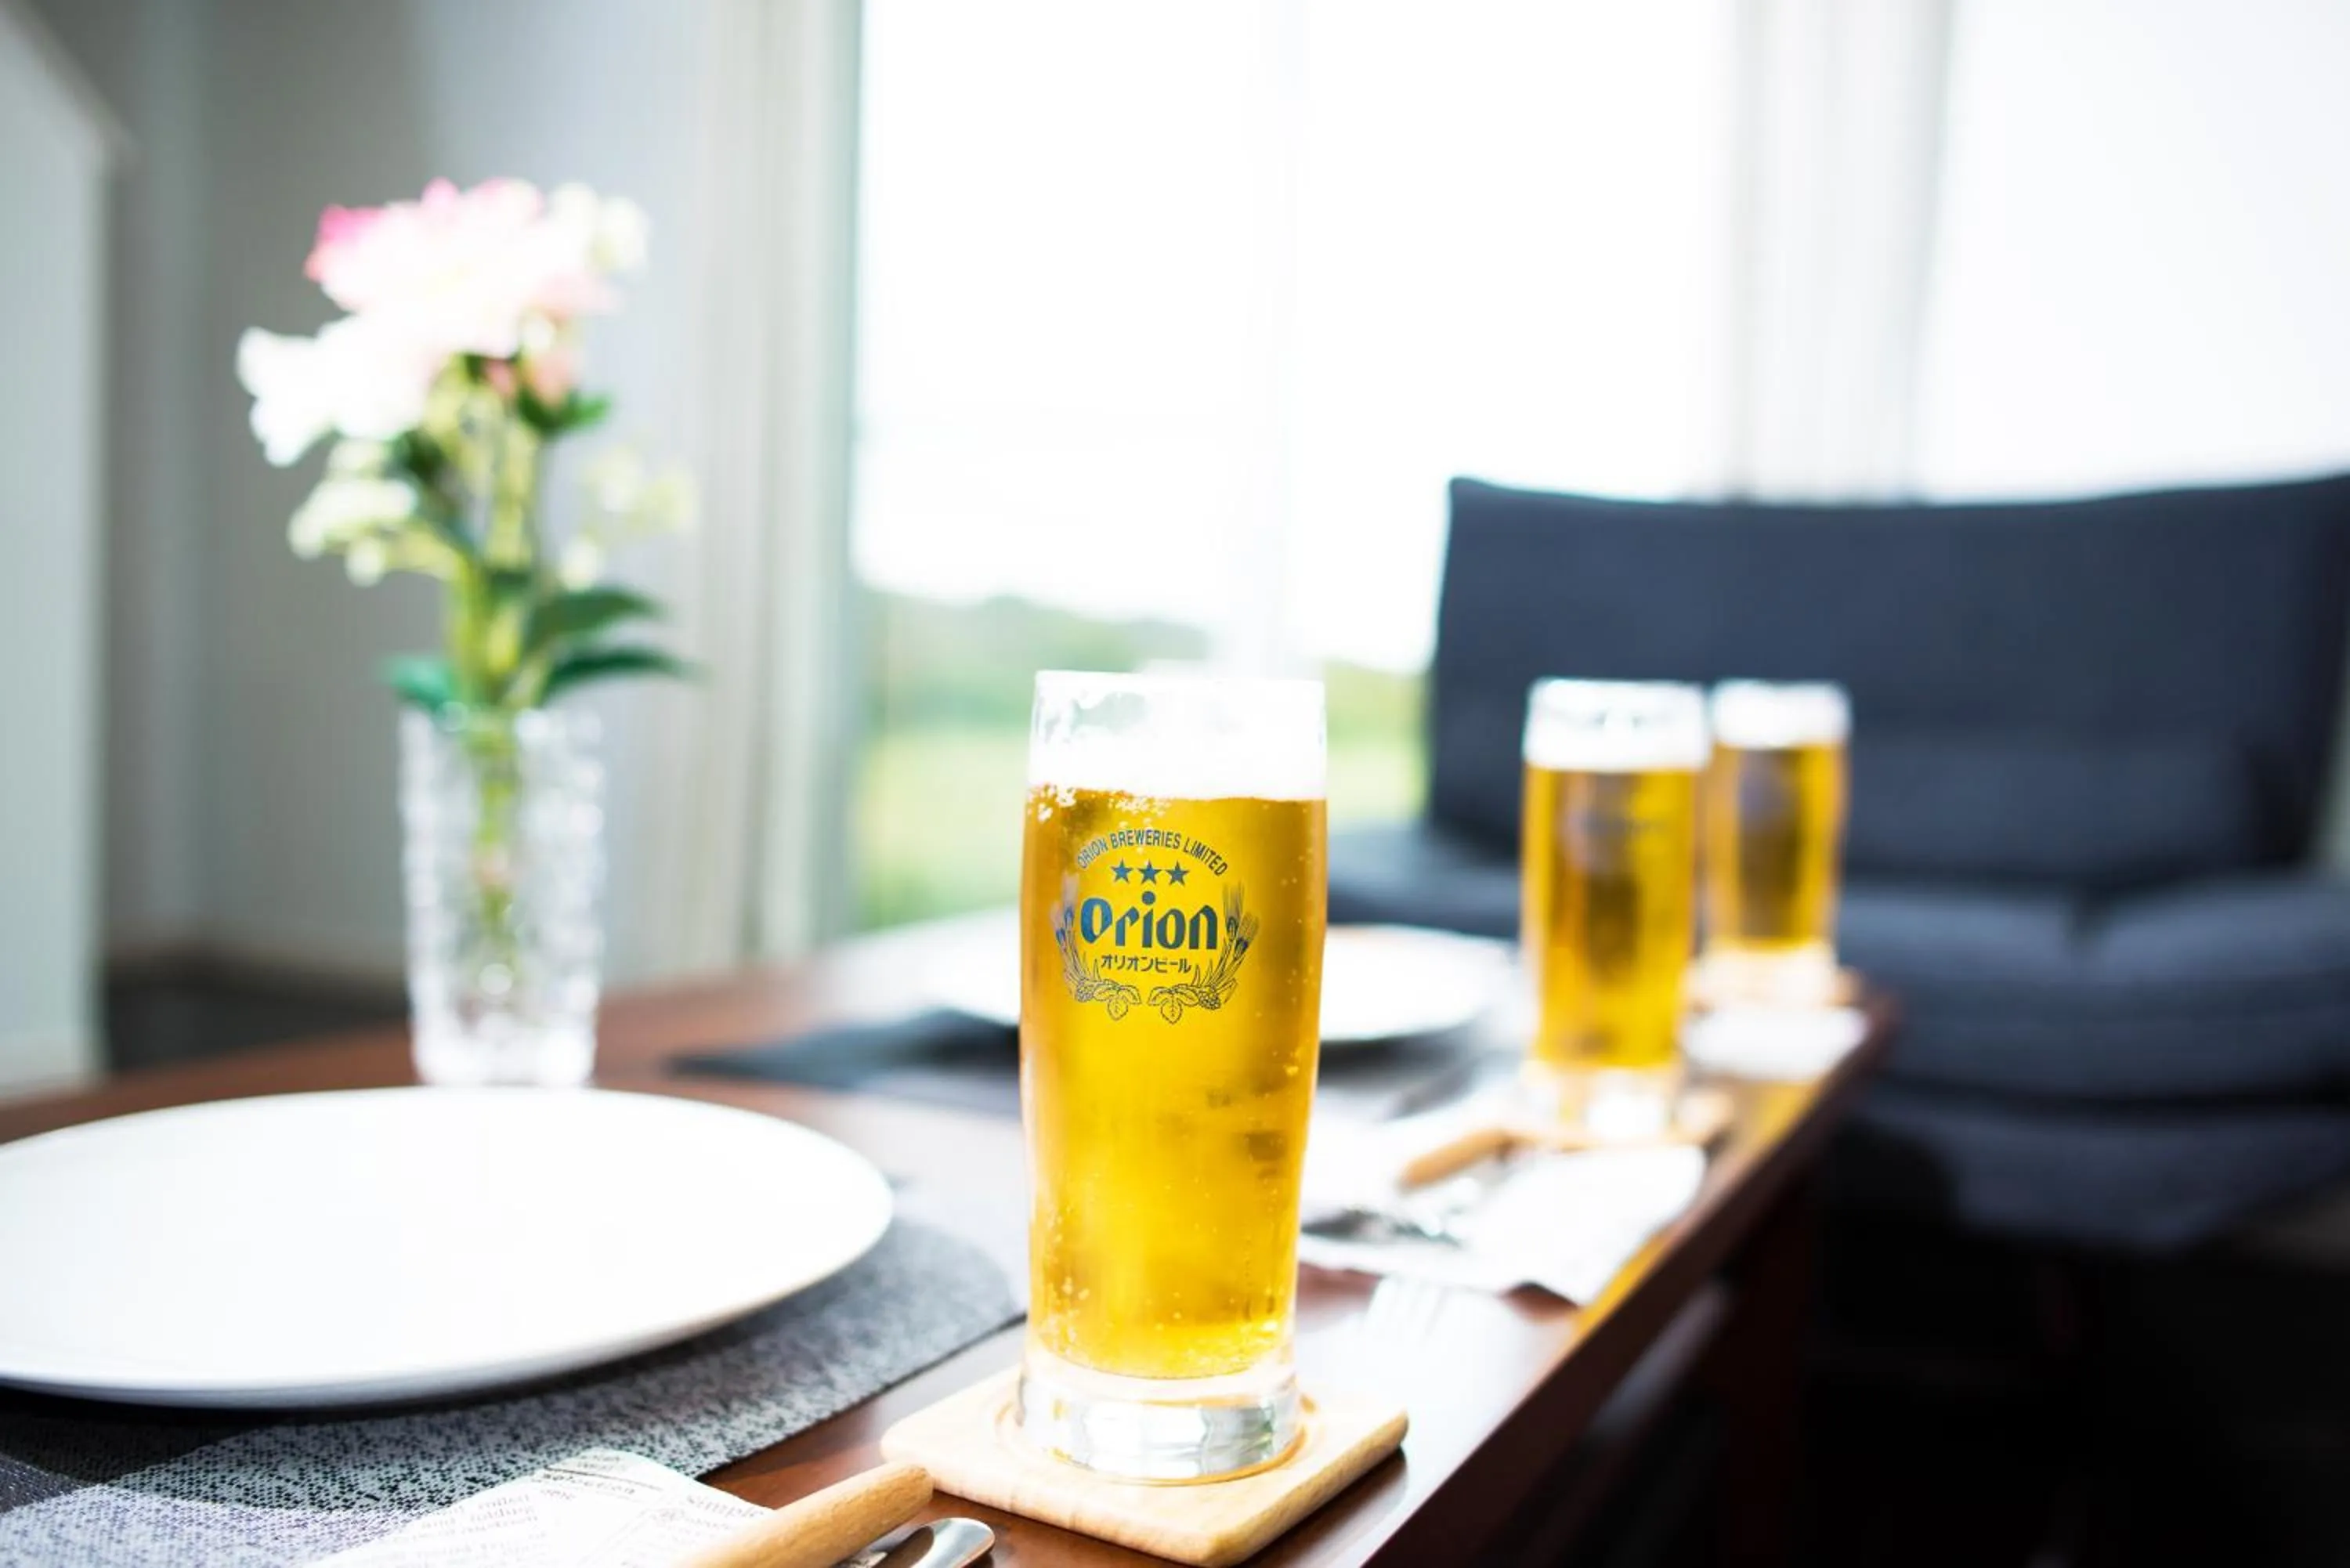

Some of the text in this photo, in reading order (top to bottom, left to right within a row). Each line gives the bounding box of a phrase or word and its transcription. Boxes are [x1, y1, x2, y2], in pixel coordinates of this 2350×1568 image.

[1077, 829, 1228, 876] ORION BREWERIES LIMITED
[1080, 891, 1218, 950] Orion
[1101, 955, 1191, 974] オリオンビール
